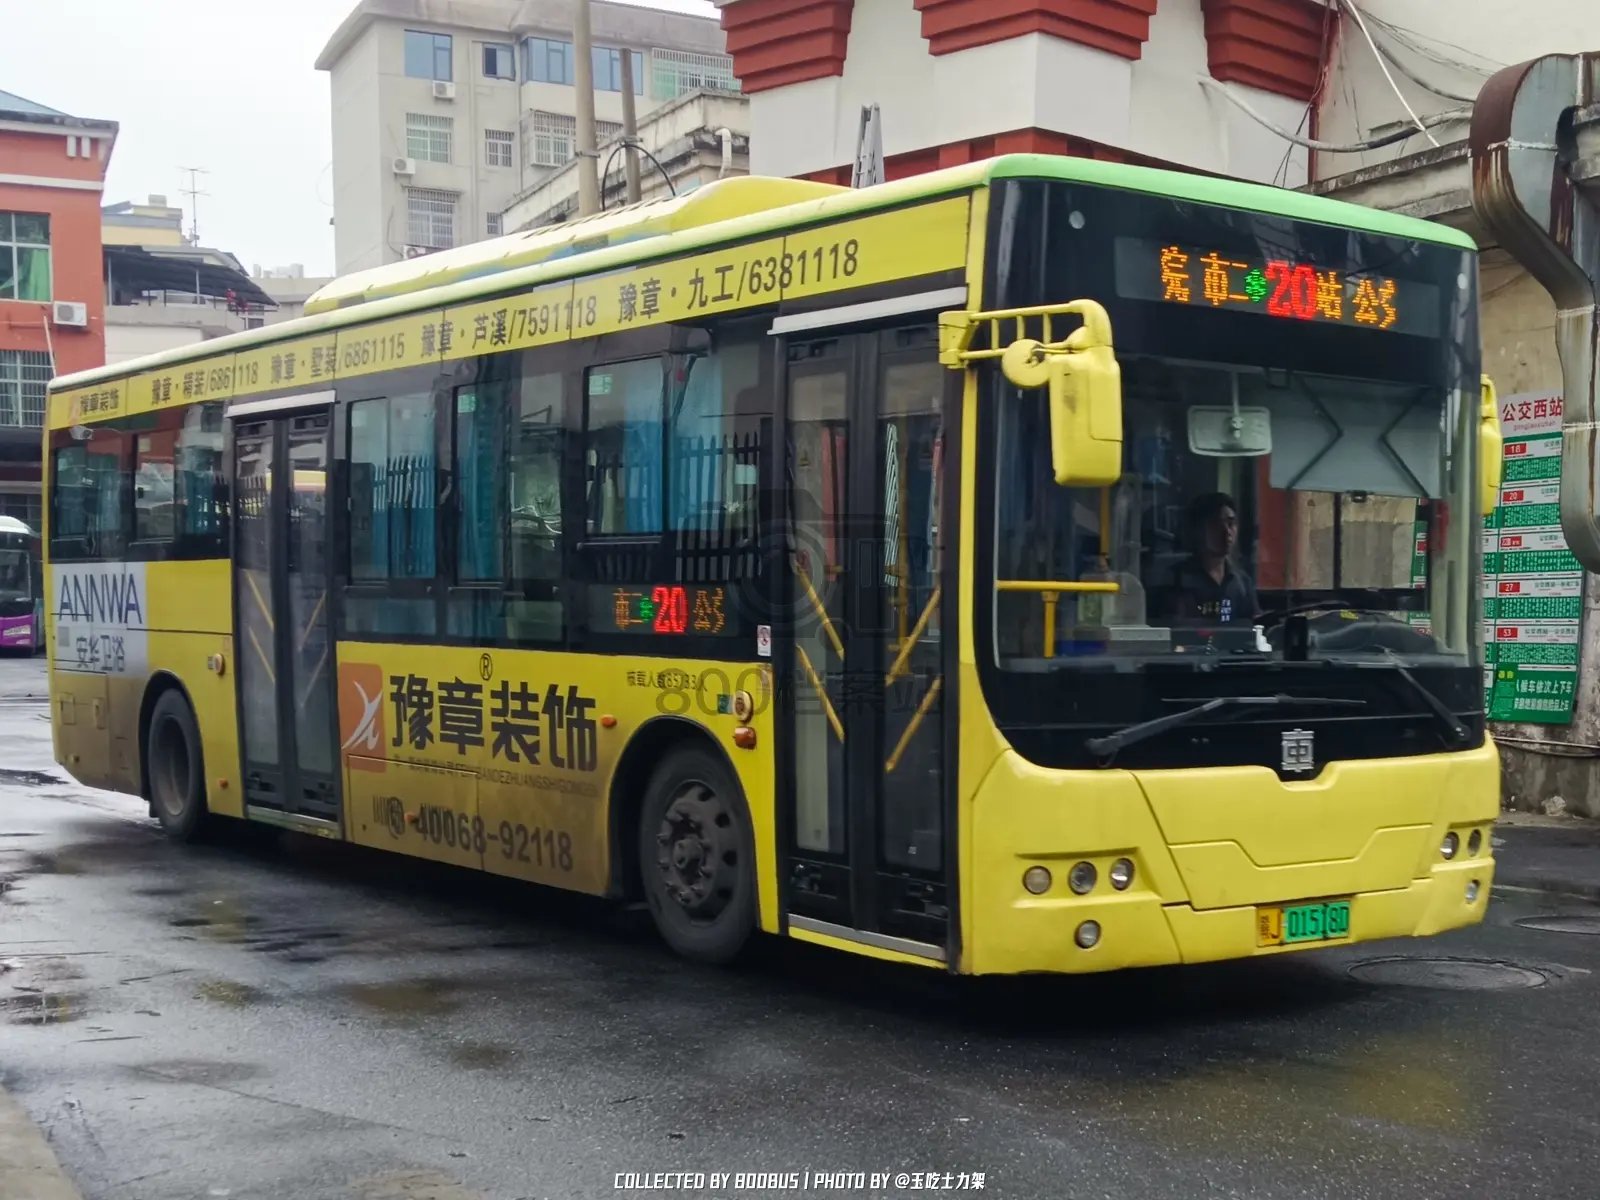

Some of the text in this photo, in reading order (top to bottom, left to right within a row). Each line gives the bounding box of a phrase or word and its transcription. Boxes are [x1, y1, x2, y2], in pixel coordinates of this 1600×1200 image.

[1264, 259, 1317, 320] 20
[1502, 396, 1563, 422] 公交西站
[1510, 445, 1521, 453] 18
[1509, 492, 1518, 500] 20
[59, 573, 143, 624] ANNWA
[1505, 584, 1514, 592] 27
[652, 586, 689, 634] 20
[76, 635, 125, 672] 安华卫浴
[389, 673, 598, 772] 豫章装饰
[415, 803, 573, 872] 40068-92118
